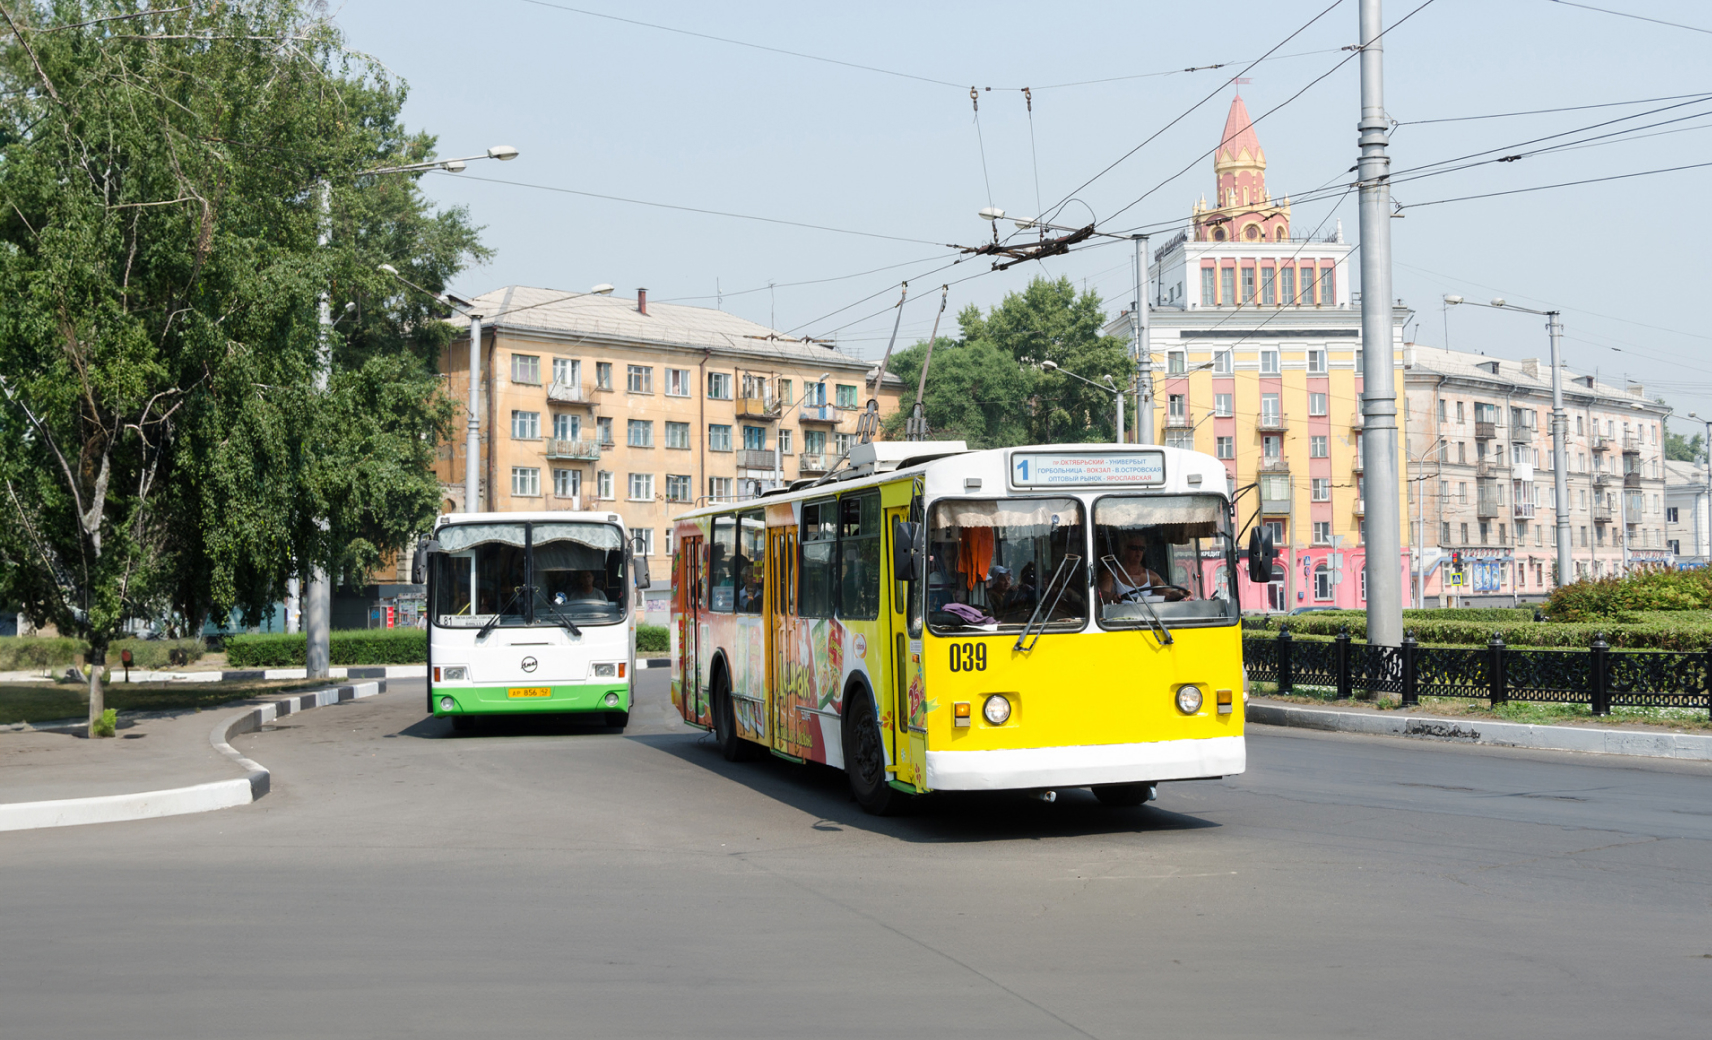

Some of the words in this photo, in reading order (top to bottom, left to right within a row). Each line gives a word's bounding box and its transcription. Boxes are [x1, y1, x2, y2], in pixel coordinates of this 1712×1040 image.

[1016, 460, 1029, 481] 1
[443, 616, 453, 626] 81
[949, 642, 987, 672] 039
[523, 689, 538, 697] 856
